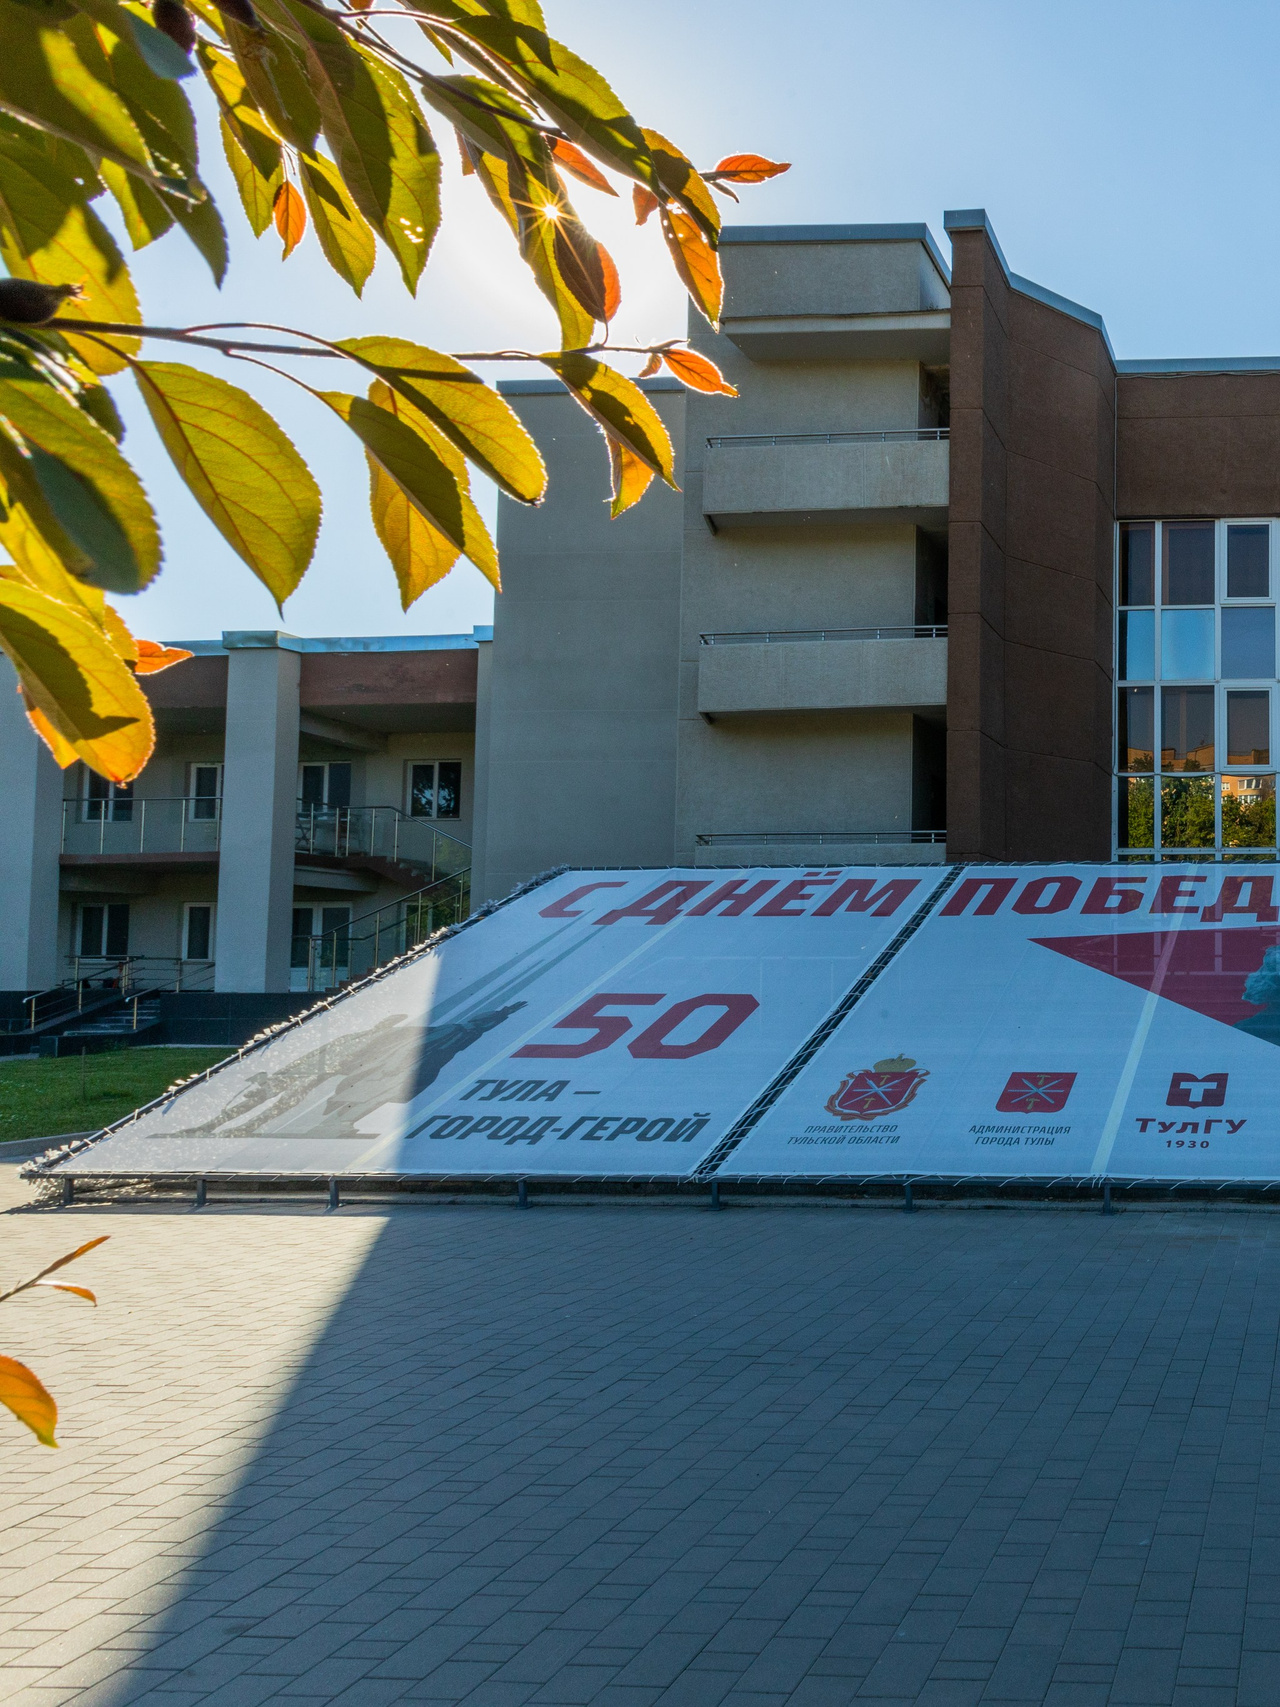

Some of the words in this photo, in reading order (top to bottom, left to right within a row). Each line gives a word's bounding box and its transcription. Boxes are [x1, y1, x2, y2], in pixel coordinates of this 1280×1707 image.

[538, 881, 629, 918] С
[591, 871, 922, 925] ДНЁМ
[509, 993, 760, 1059] 50
[459, 1079, 571, 1101] ТУЛА
[404, 1112, 711, 1145] ГОРОД-ГЕРОЙ
[804, 1125, 898, 1133] ПРАВИТЕЛЬСТВО
[969, 1125, 1071, 1135] АДМИНИСТРАЦИЯ
[787, 1135, 847, 1144] ТУЛЬСКОЙ
[848, 1136, 900, 1144] ОБЛАСТИ
[975, 1137, 1020, 1146] ГОРОДА
[1024, 1137, 1055, 1145] ТУЛЫ
[1166, 1140, 1210, 1149] 1930
